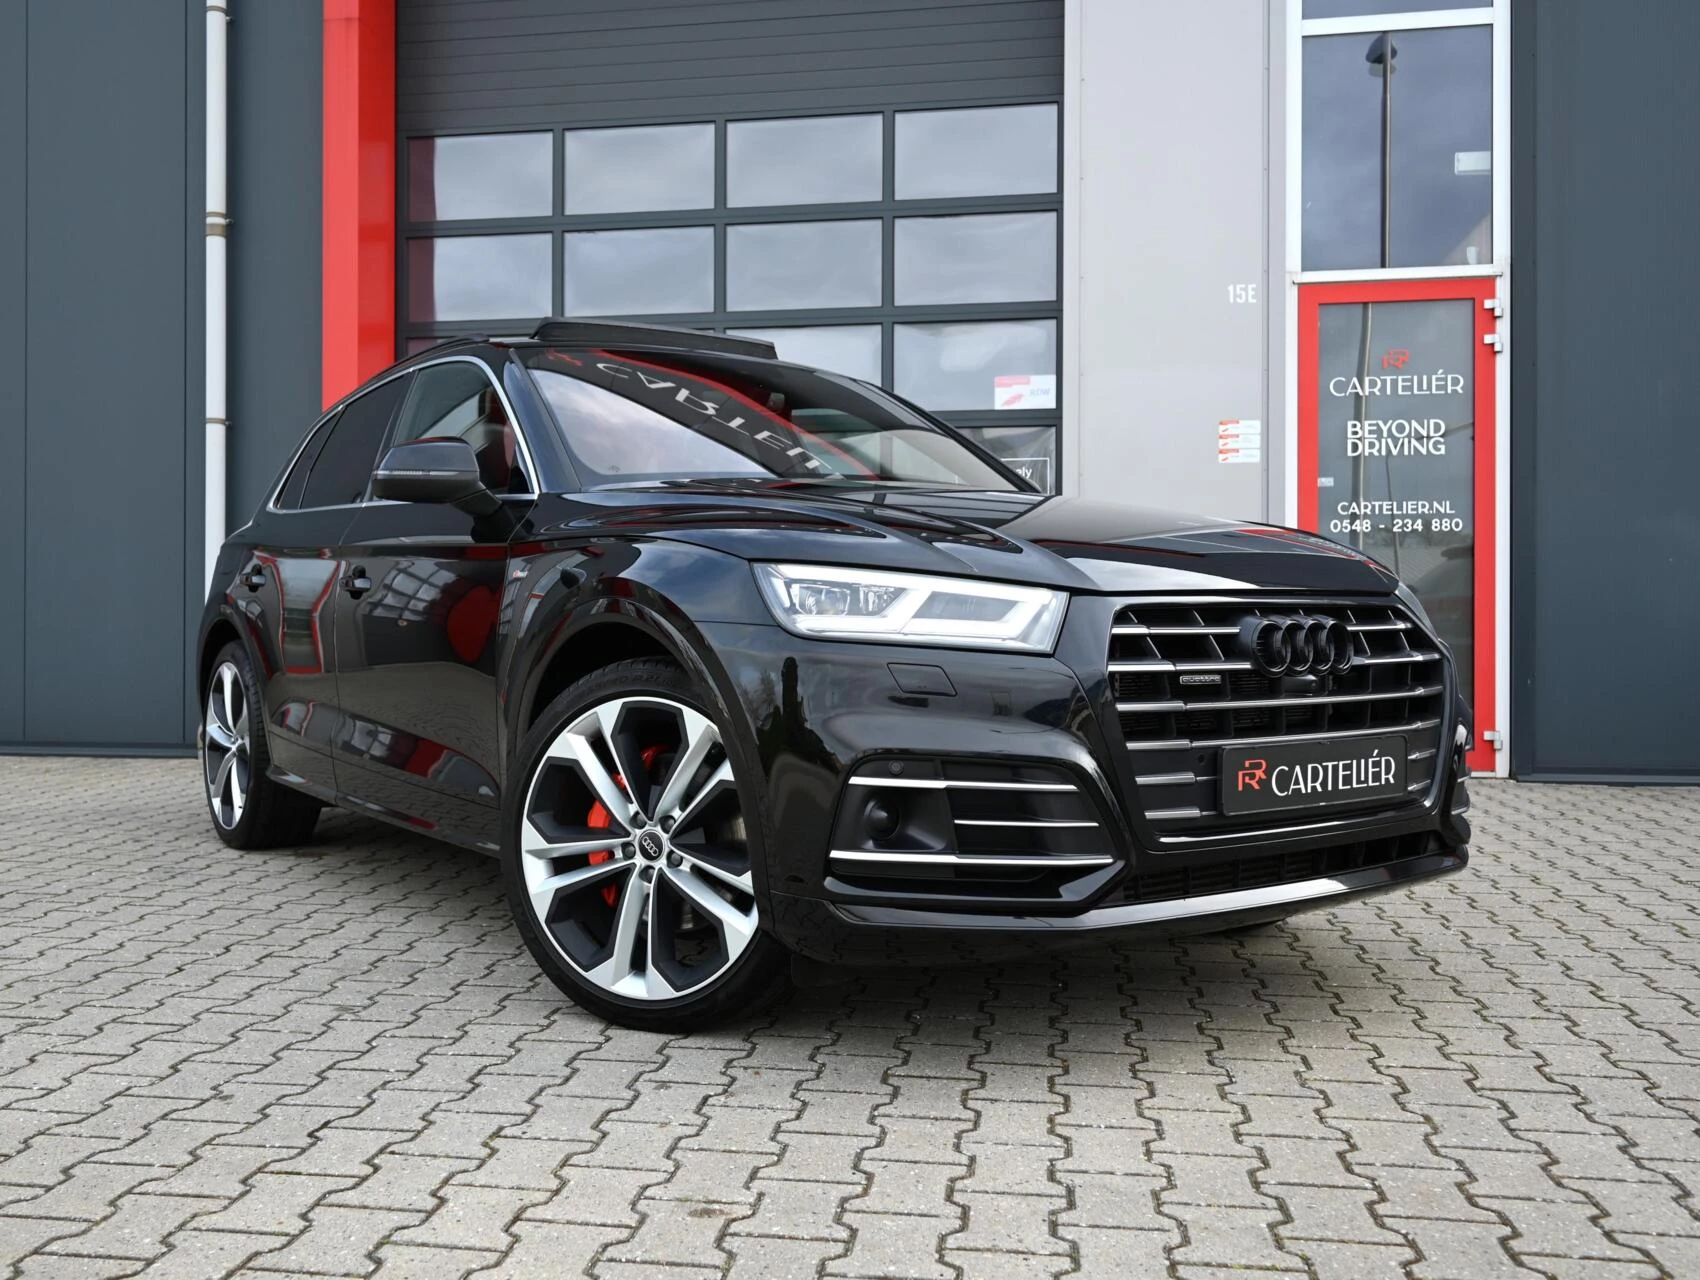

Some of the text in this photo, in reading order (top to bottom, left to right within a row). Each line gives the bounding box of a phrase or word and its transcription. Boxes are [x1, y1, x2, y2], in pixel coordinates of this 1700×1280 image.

[1227, 283, 1257, 303] 15E
[1329, 369, 1464, 397] CARTELIÉR
[1347, 419, 1446, 440] BEYOND
[1347, 437, 1446, 457] DRIVING
[1337, 500, 1456, 516] CARTELIER.NL
[1330, 519, 1372, 533] 0548
[1392, 518, 1423, 532] 234
[1431, 518, 1463, 532] 880
[1271, 749, 1395, 797] CARTELIÉR
